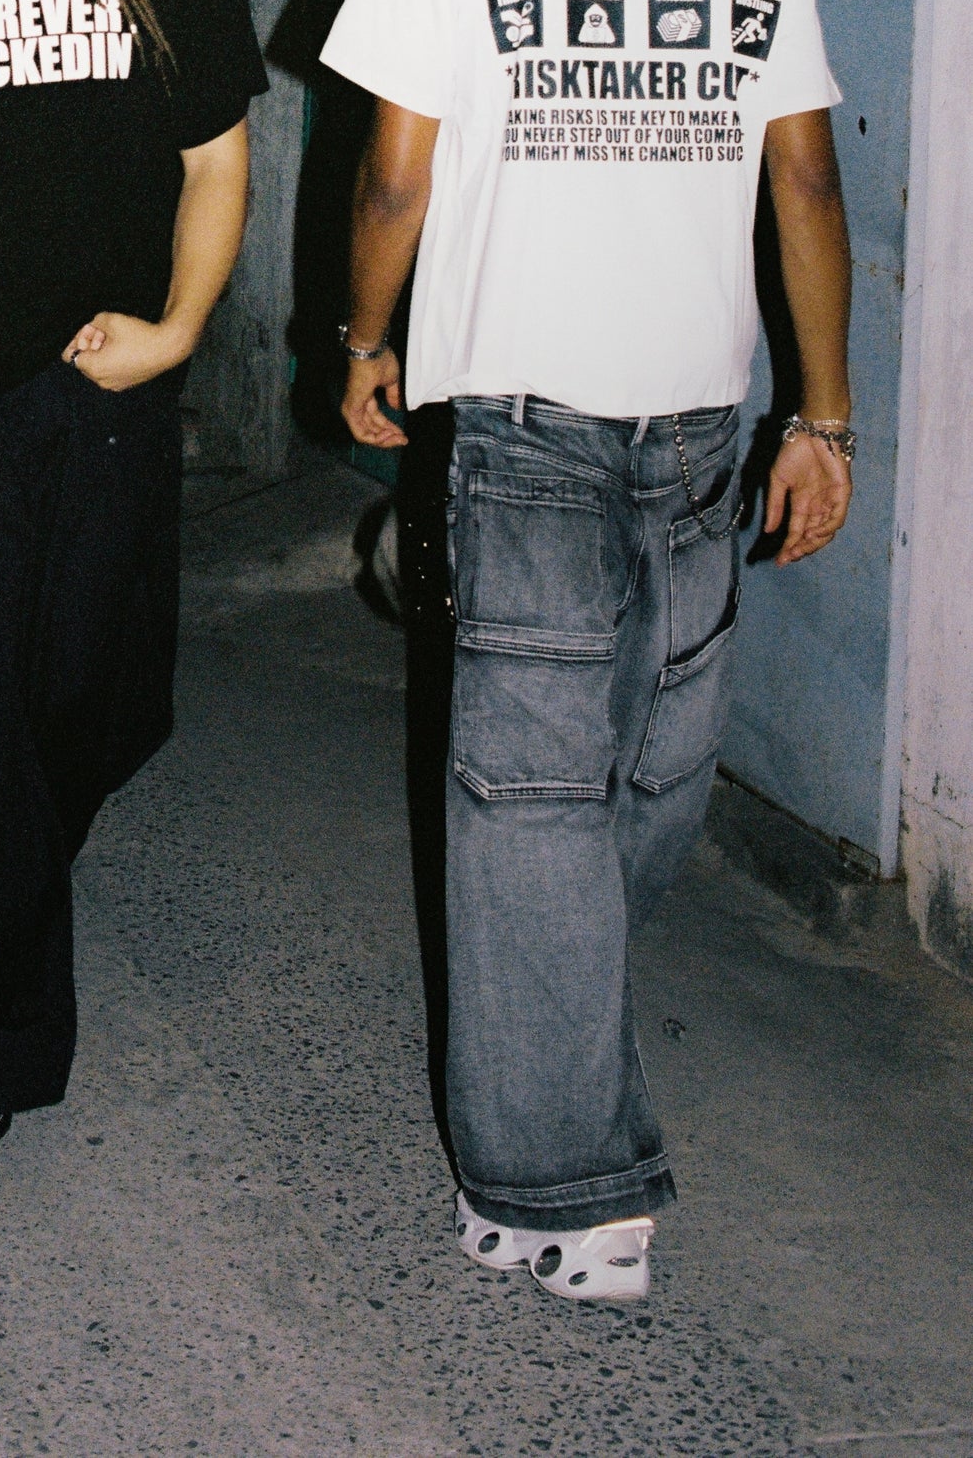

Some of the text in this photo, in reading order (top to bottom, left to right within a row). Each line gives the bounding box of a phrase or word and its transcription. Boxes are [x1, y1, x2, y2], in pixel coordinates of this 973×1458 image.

[507, 109, 546, 125] AKING
[550, 109, 593, 125] RISKS
[596, 109, 608, 126] IS
[611, 110, 636, 126] THE
[640, 110, 666, 126] KEY
[669, 110, 685, 126] TO
[688, 110, 728, 126] MAKE
[505, 127, 744, 144] OU NEVER STEP OUT OF YOUR COMFO
[525, 145, 569, 161] MIGHT
[573, 145, 608, 161] MISS
[611, 145, 635, 162] THE
[638, 146, 694, 162] CHANCE
[697, 146, 713, 162] TO
[717, 146, 744, 162] SUC
